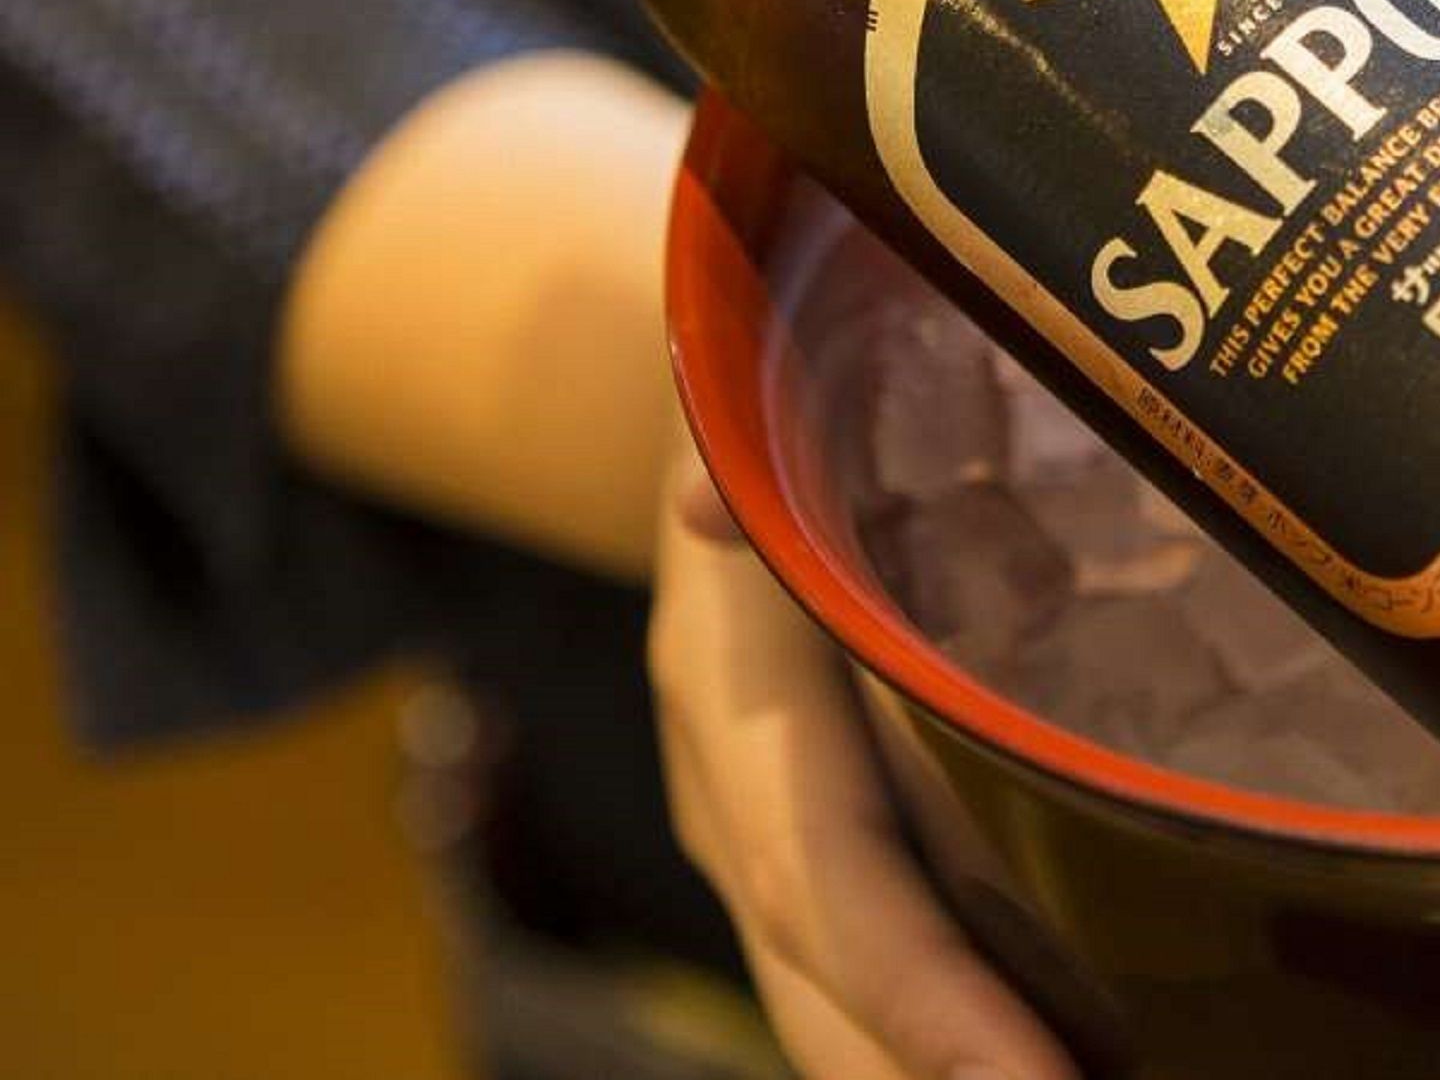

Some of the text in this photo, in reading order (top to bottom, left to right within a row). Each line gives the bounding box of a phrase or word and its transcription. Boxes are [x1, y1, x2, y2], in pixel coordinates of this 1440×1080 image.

[1210, 324, 1250, 377] THIS
[1244, 222, 1325, 325] PERFECT
[1321, 123, 1422, 226] BALANCE
[1248, 307, 1300, 378] GIVES
[1296, 256, 1342, 306] YOU
[1338, 239, 1362, 259] A
[1355, 163, 1426, 238] GREAT
[1282, 313, 1339, 385] FROM
[1330, 263, 1379, 314] THE
[1372, 202, 1430, 264] VERY
